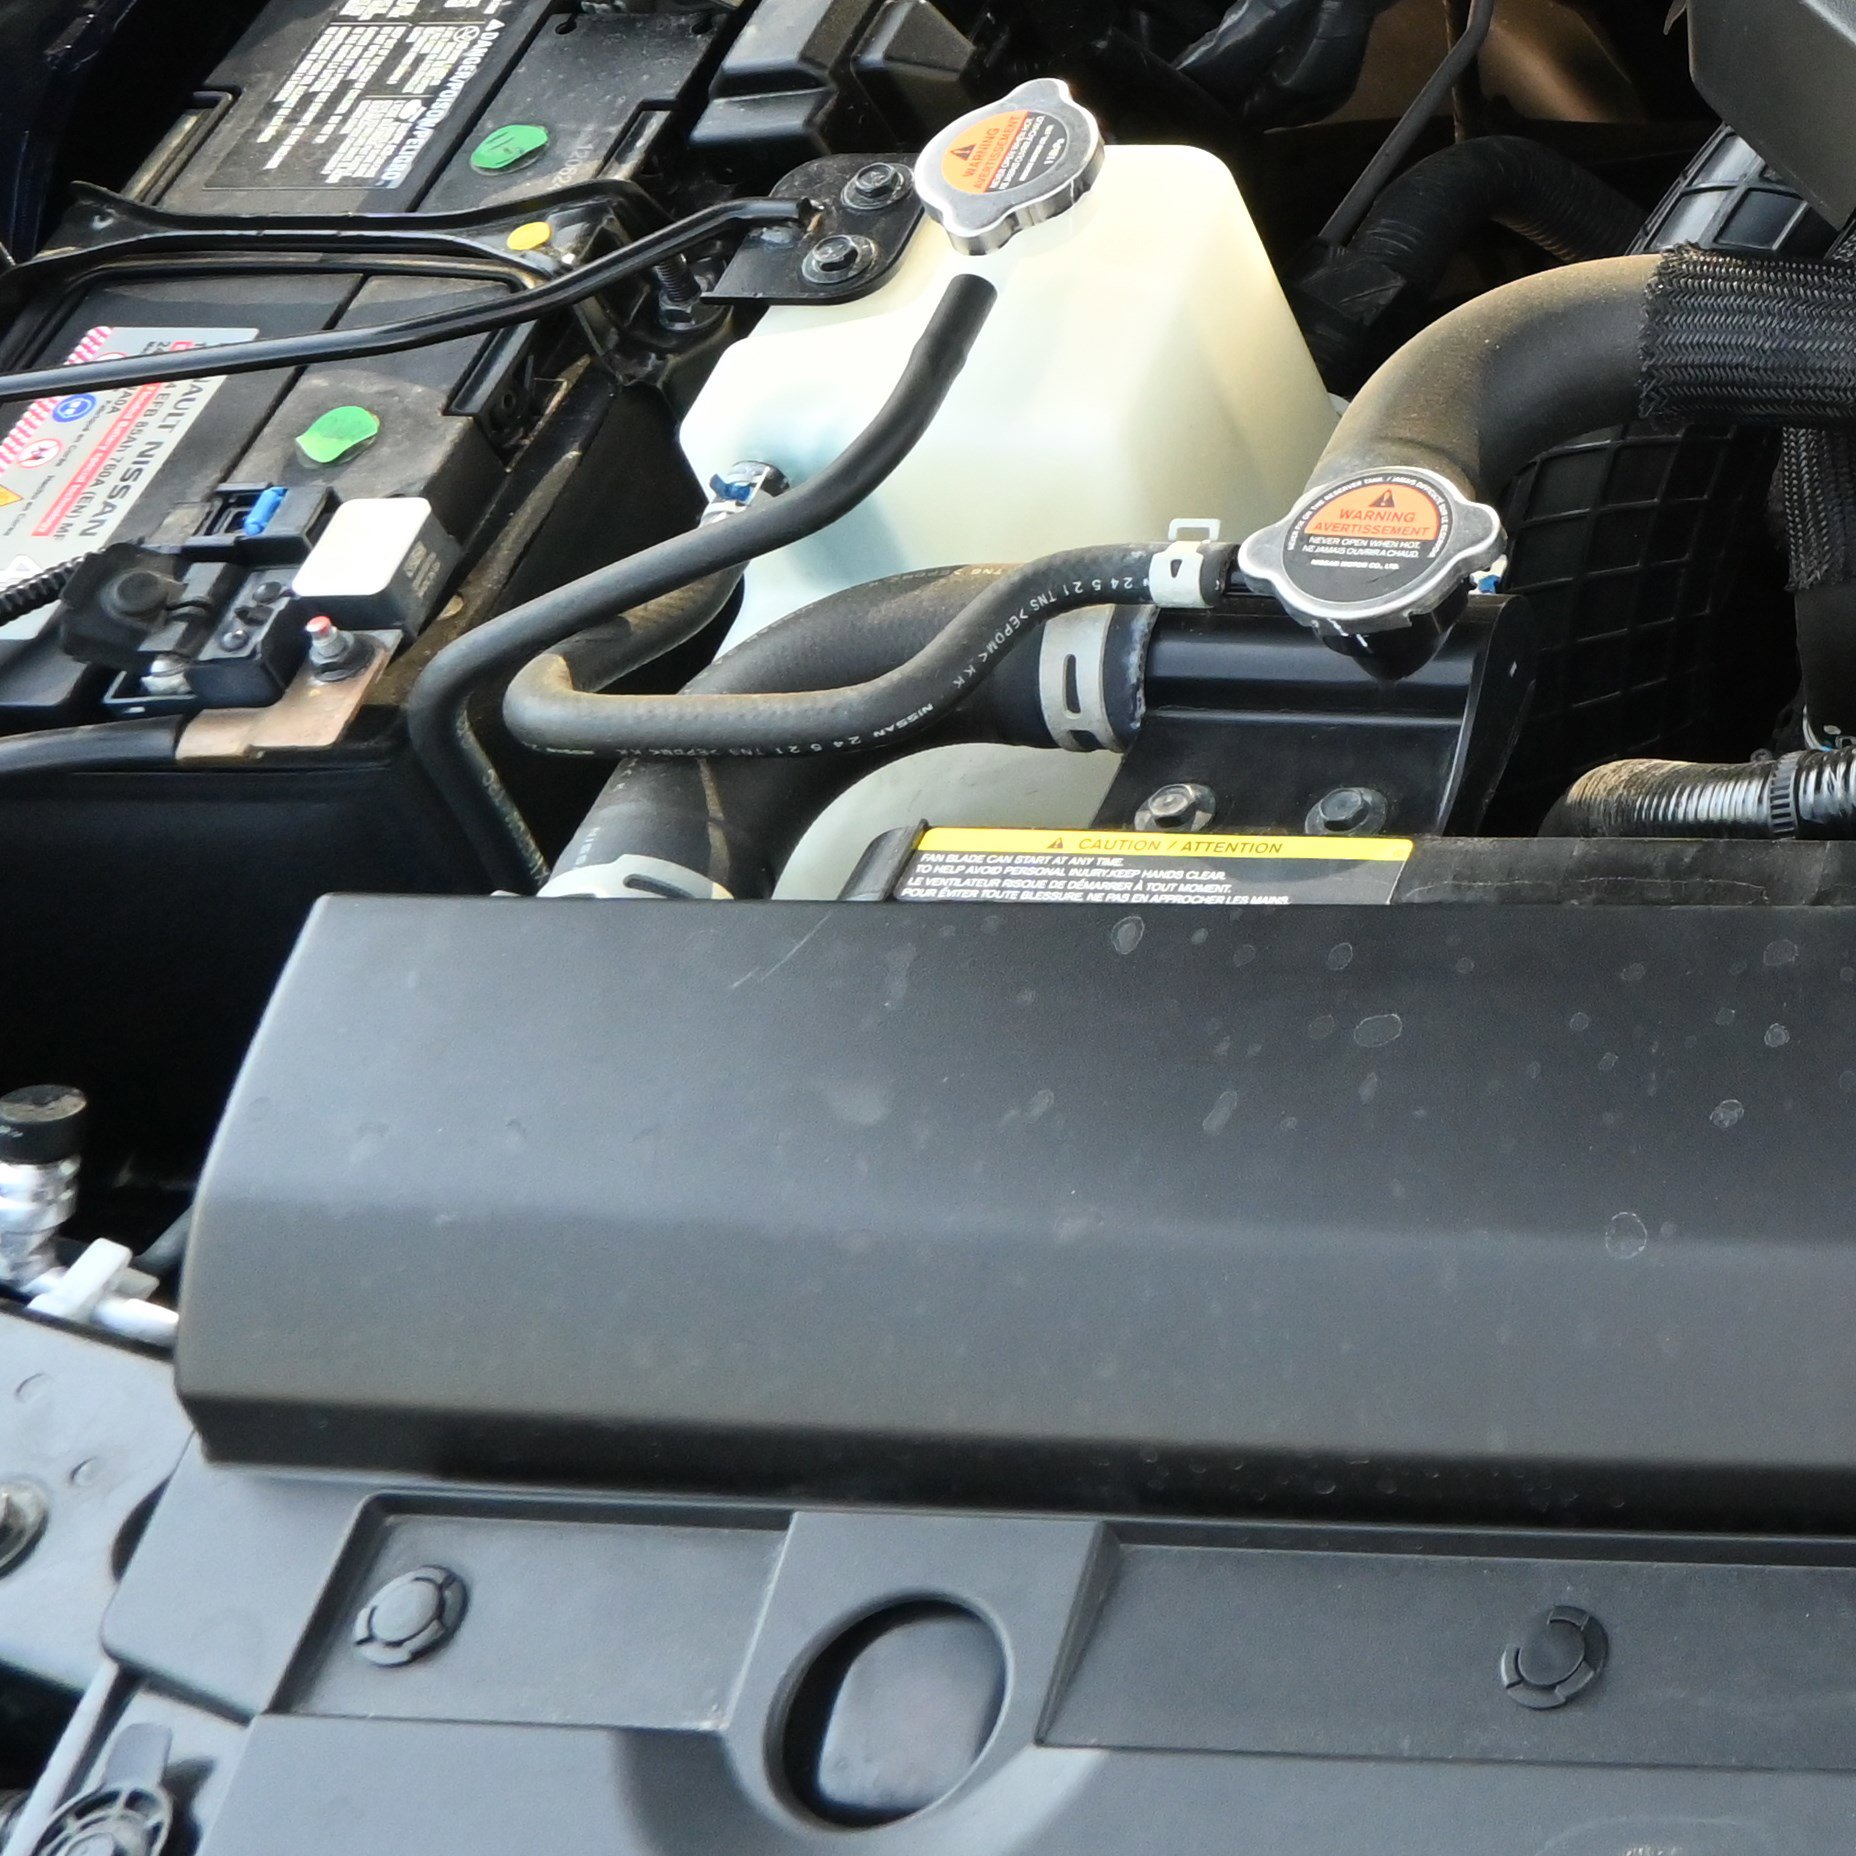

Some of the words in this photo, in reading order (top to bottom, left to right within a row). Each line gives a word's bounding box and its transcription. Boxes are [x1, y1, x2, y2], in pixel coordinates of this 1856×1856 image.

[963, 127, 1000, 177] WARNING
[973, 115, 1021, 189] AVERTISSEMENT
[79, 441, 163, 536] NISSAN
[1339, 508, 1416, 523] WARNING
[1313, 522, 1431, 537] AVERTISSEMENT
[1309, 536, 1340, 546] NEVER
[1341, 537, 1369, 546] OPEN
[1369, 538, 1399, 548] WHEN
[1062, 580, 1084, 596] 21
[1091, 578, 1102, 591] 5
[1110, 576, 1134, 590] 24
[1029, 590, 1058, 612] TNS
[872, 702, 935, 739] NISSAN
[1079, 838, 1160, 851] CAUTION
[1180, 841, 1283, 854] ATTENTION
[920, 854, 944, 863] FAN
[946, 854, 985, 863] BLADE
[986, 855, 1011, 864] CAN
[1014, 855, 1051, 865] START
[1053, 856, 1069, 865] AT
[1070, 856, 1094, 866] ANY
[915, 864, 932, 873] TO
[933, 865, 964, 874] HELP
[965, 865, 1002, 875] AVOID
[1003, 866, 1066, 876] PERSONAL
[1142, 870, 1184, 879] HANDS
[908, 877, 922, 886] LE
[922, 877, 1000, 888] VENTILATEUR
[1002, 879, 1046, 890] RISQUE
[1049, 880, 1066, 889] DE
[1067, 878, 1133, 890] DÉMARRER
[1146, 881, 1177, 892] TOUT
[901, 888, 937, 898] POUR
[937, 887, 984, 899] ÉVITER
[984, 889, 1018, 900] TOUTE
[1086, 893, 1103, 902] NE
[1105, 893, 1130, 902] PAS
[1131, 894, 1149, 903] EN
[1149, 894, 1226, 905] APPROCHER
[1226, 895, 1249, 905] LES
